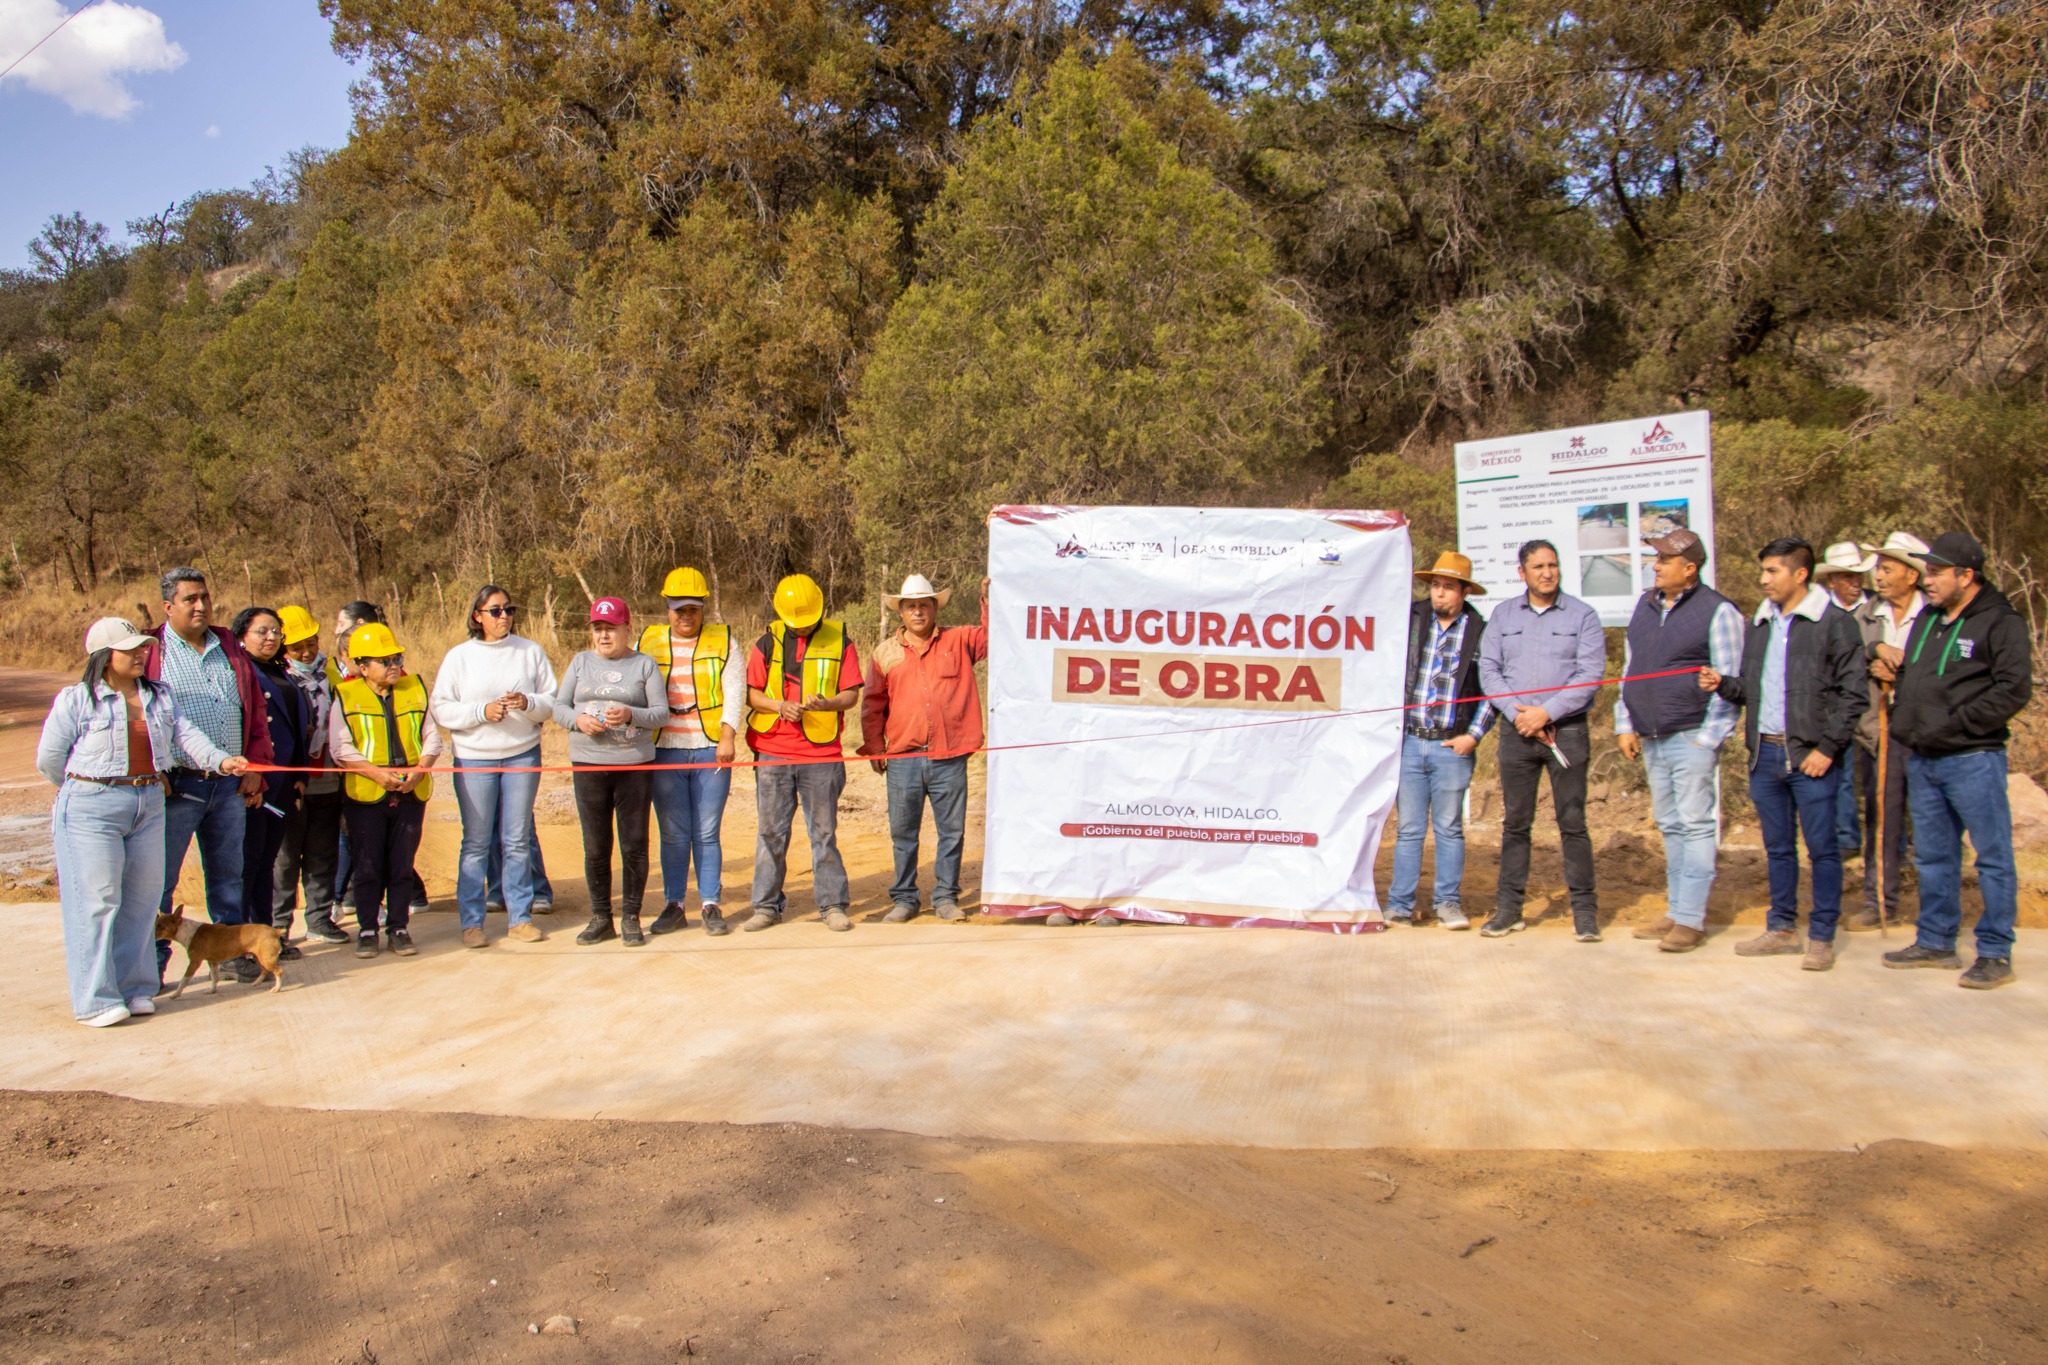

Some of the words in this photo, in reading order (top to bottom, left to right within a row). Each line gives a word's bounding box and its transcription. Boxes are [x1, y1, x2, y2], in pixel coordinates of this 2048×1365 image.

[1480, 449, 1512, 457] GOBIERNO
[1551, 446, 1608, 460] HIDALGO
[1630, 442, 1687, 456] ALMOLOYA
[1481, 454, 1522, 467] MÉXICO
[1620, 482, 1650, 490] LOCALIDAD
[1026, 605, 1375, 651] INAUGURACIÓN
[1066, 656, 1141, 696] DE
[1158, 659, 1326, 702] OBRA
[1105, 803, 1199, 820] ALMOLOYA,
[1203, 806, 1282, 822] HIDALGO.
[1082, 824, 1142, 838] ¡Gobierno
[1145, 826, 1164, 838] del
[1166, 827, 1211, 842] pueblo,
[1214, 831, 1241, 843] para
[1243, 830, 1255, 842] el
[1258, 830, 1304, 845] pueblo!
